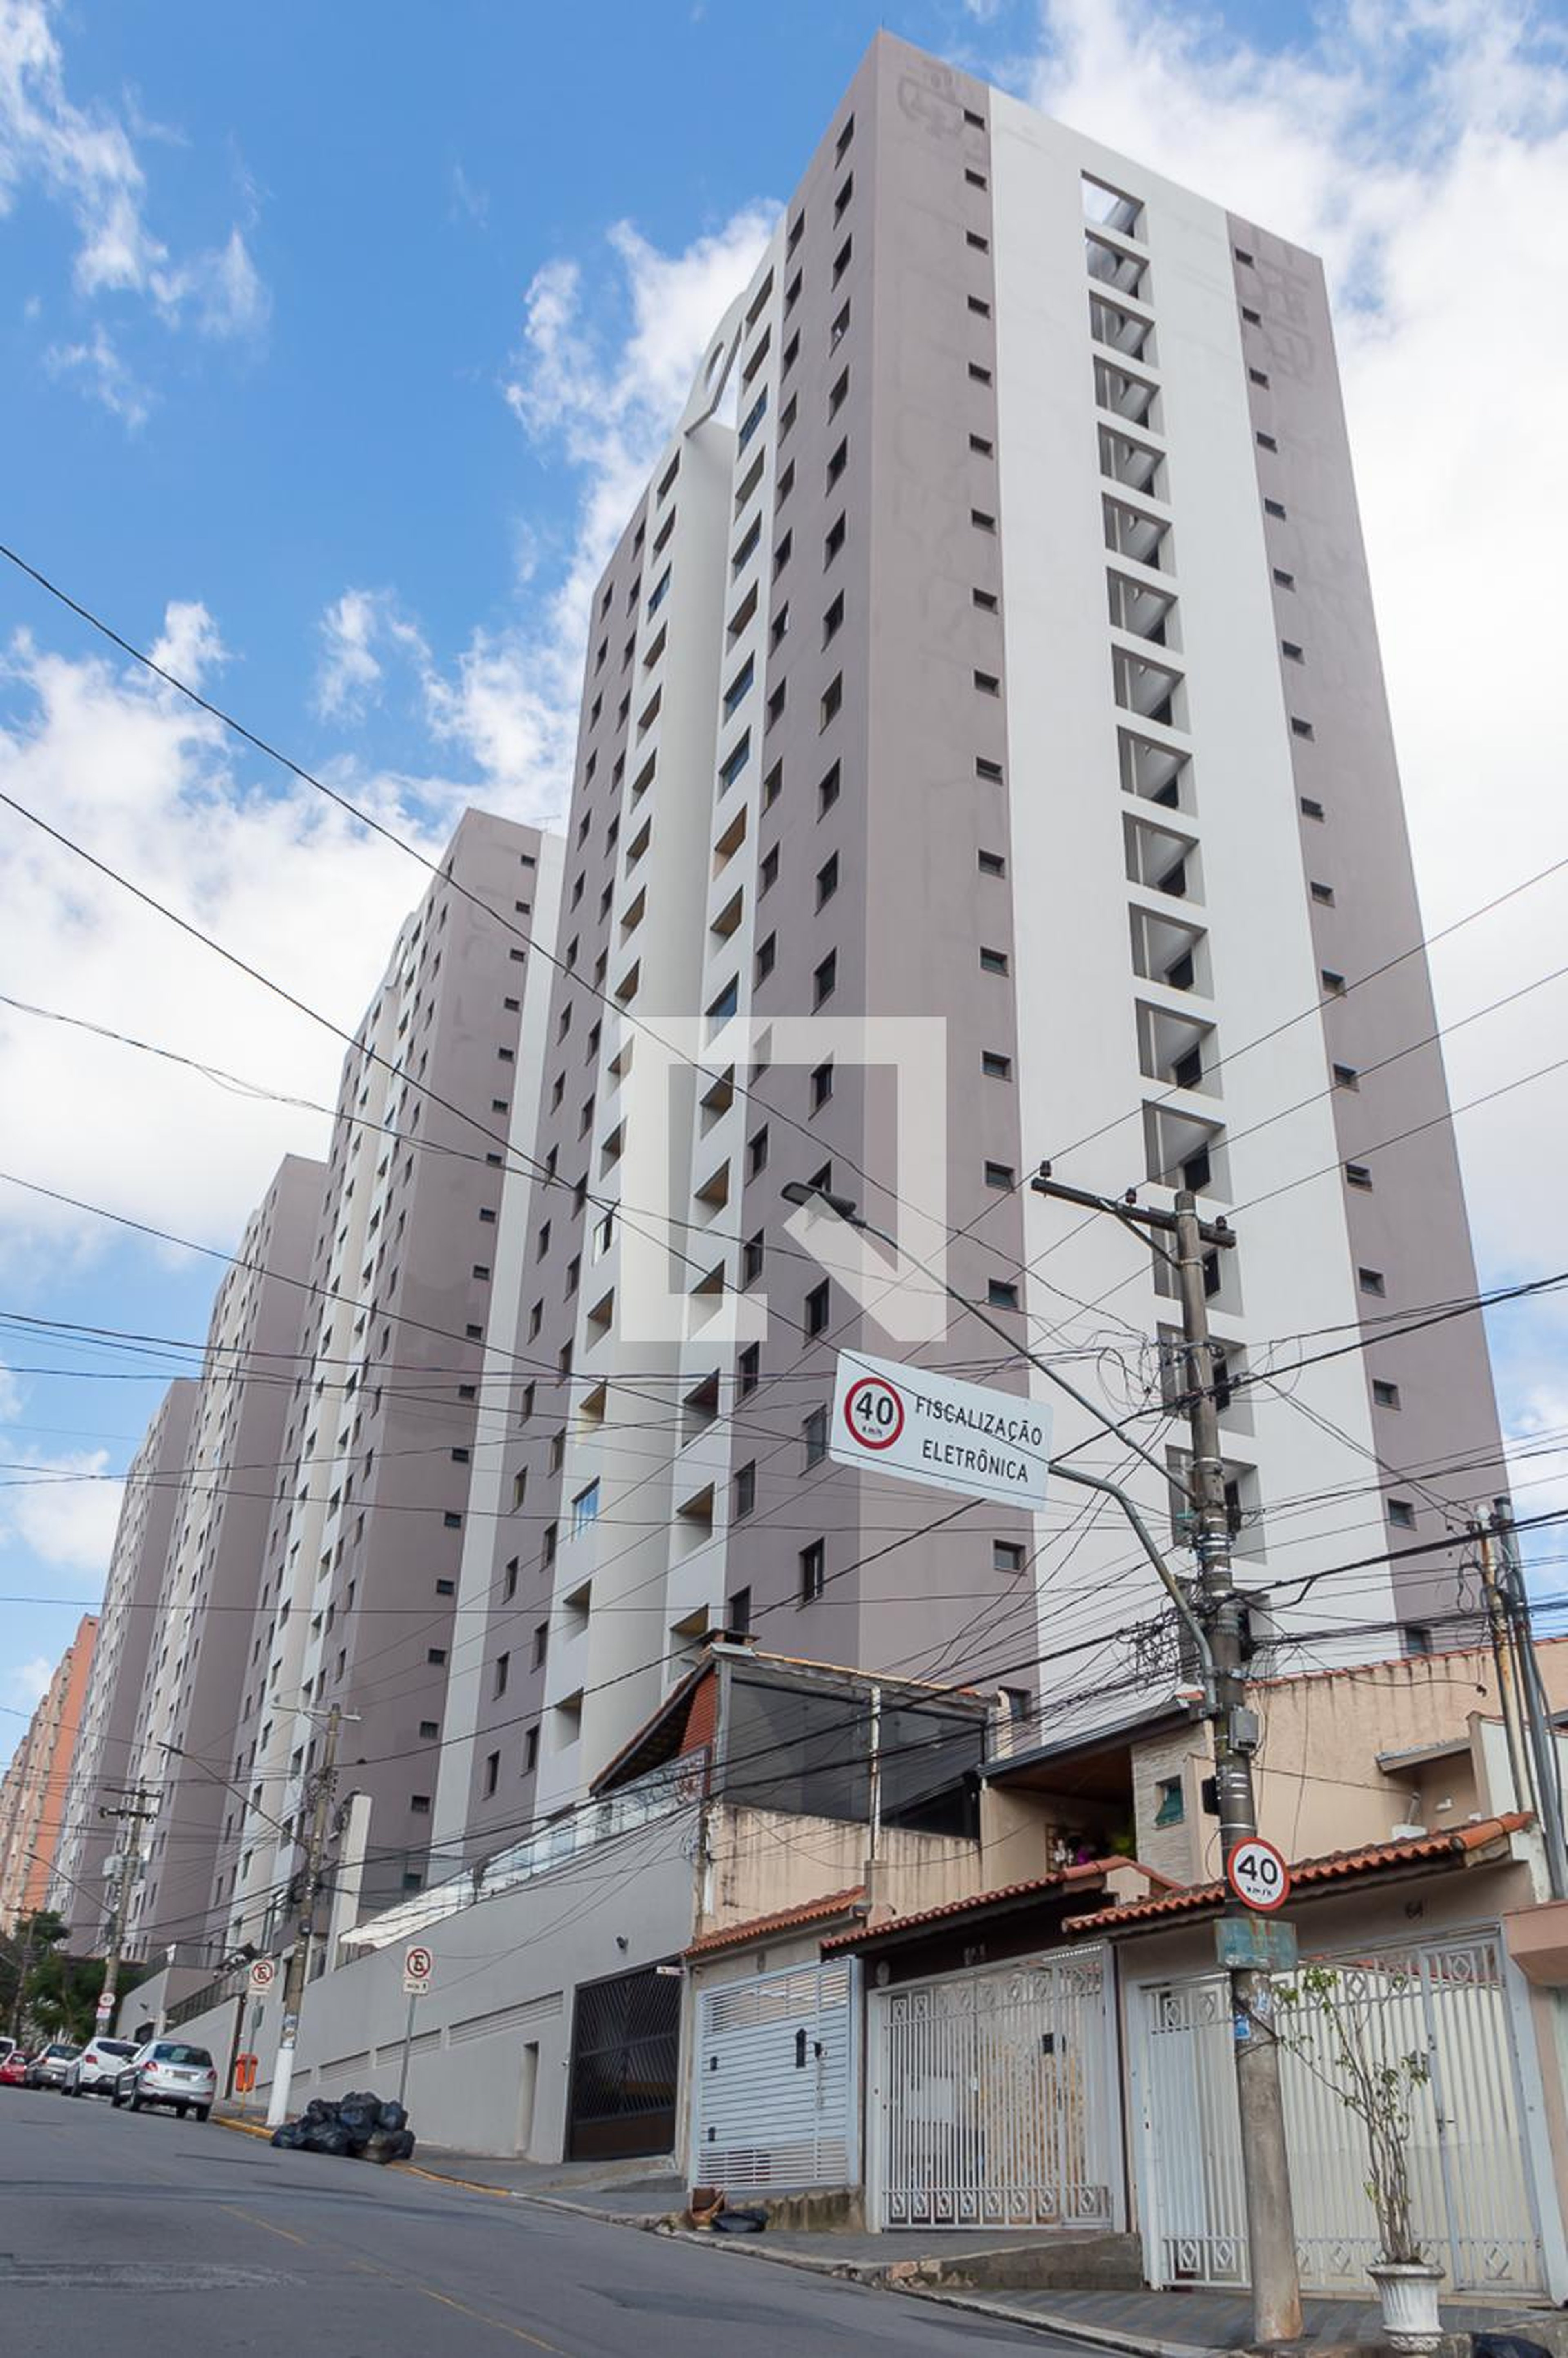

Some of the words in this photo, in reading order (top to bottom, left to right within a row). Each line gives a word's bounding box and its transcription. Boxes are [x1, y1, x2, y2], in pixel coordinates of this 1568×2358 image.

[856, 1392, 893, 1425] 40
[916, 1396, 1042, 1446] FISCALIZAÇÃO
[922, 1439, 1028, 1483] ELETRÔNICA
[1238, 1854, 1277, 1884] 40
